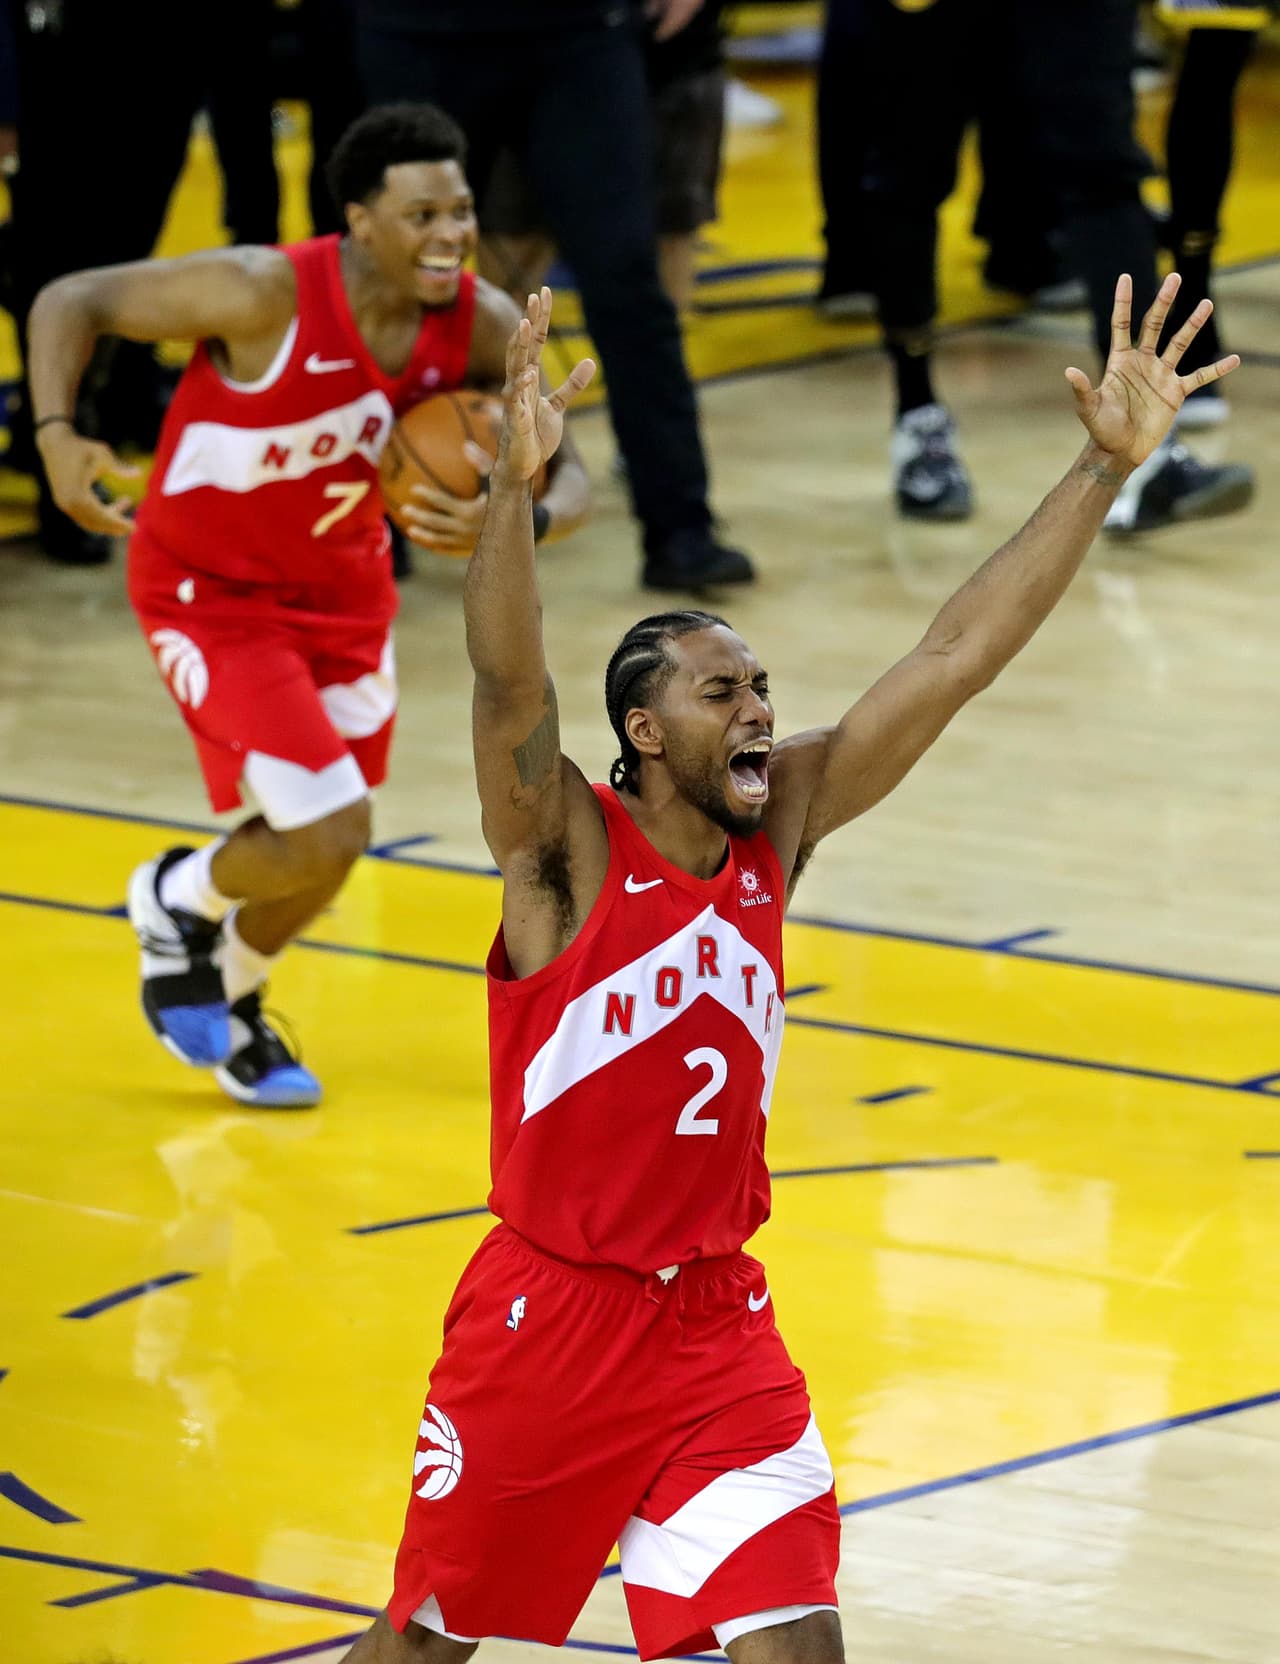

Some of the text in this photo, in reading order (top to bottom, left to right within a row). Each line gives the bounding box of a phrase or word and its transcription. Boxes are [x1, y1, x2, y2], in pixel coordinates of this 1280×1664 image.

[310, 481, 370, 538] 7
[739, 892, 772, 907] Sun Life
[675, 1047, 728, 1135] 2
